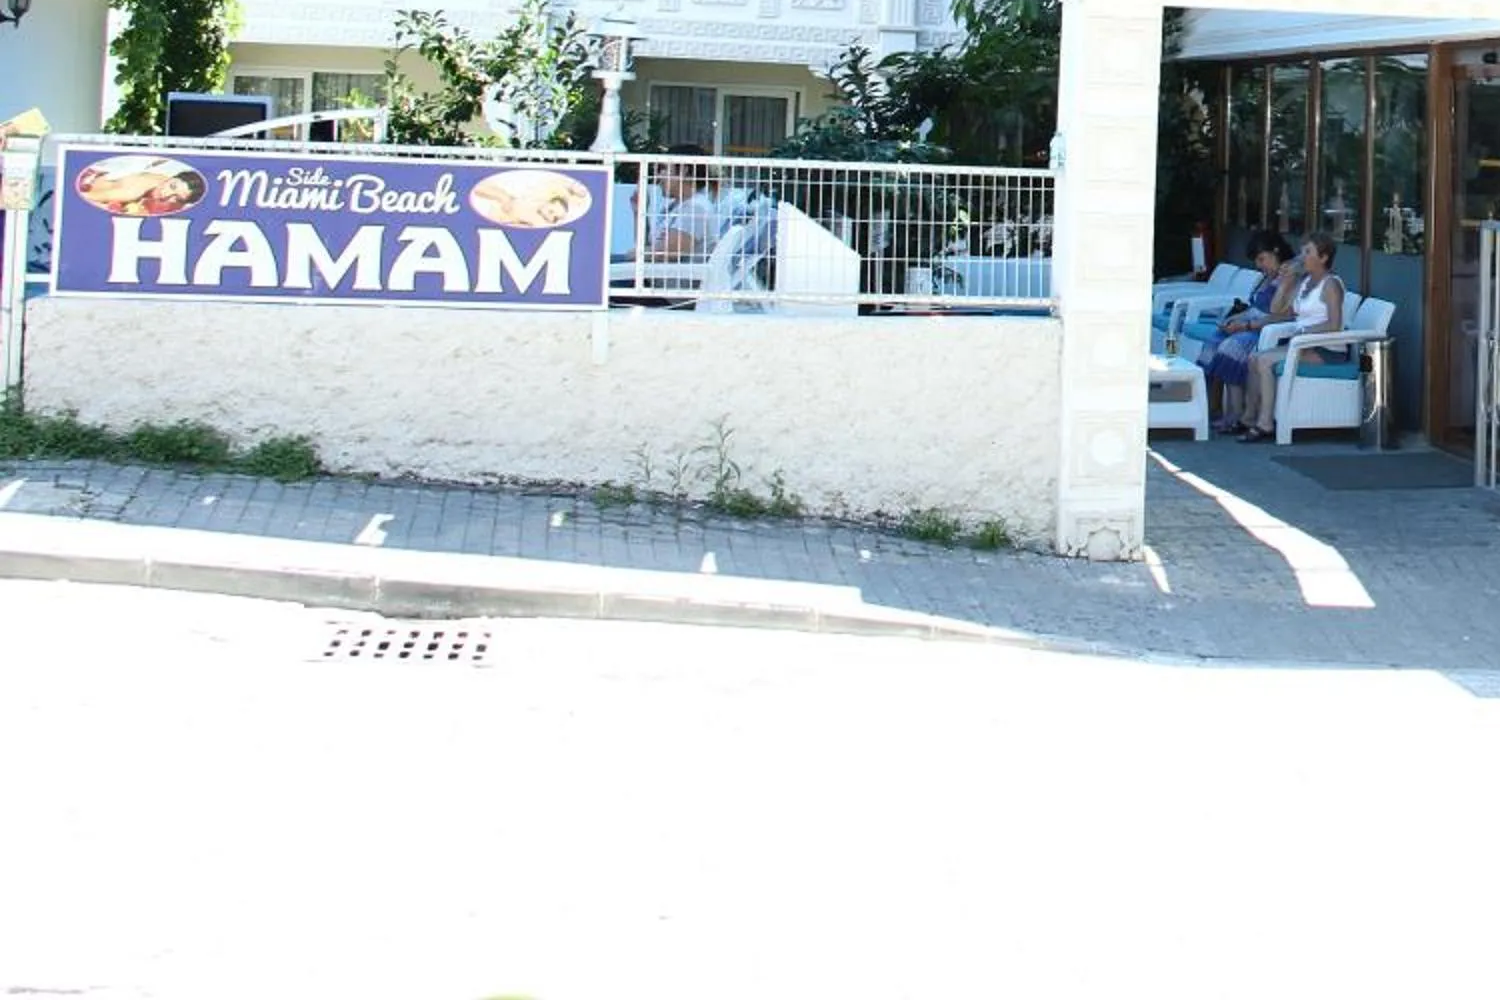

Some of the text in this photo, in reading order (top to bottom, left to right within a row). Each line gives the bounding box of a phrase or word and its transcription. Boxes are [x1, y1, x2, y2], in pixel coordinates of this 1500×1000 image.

[217, 168, 461, 214] Miami Beach
[286, 167, 330, 187] Side
[106, 215, 576, 295] HAMAM
